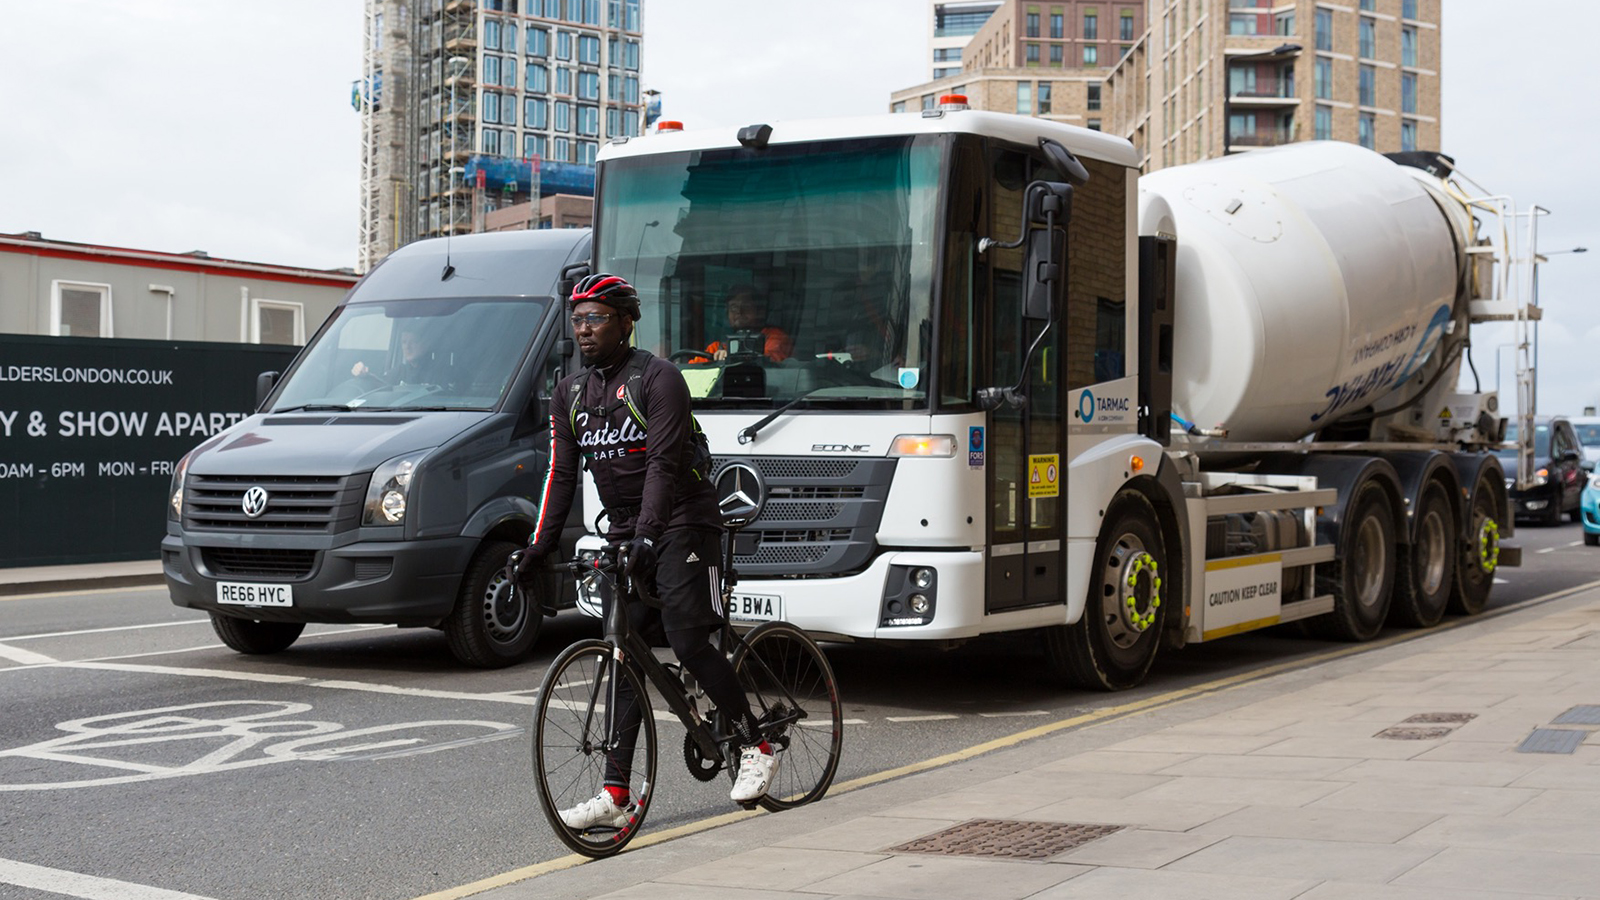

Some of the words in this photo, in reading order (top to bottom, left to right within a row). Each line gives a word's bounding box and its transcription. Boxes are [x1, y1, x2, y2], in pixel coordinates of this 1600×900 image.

[0, 366, 173, 384] LDERSLONDON.CO.UK
[1311, 353, 1406, 422] TARMAC
[1097, 398, 1129, 411] TARMAC
[0, 411, 18, 436] Y
[27, 411, 47, 437] &
[59, 411, 148, 437] SHOW
[594, 448, 625, 460] CAFE
[811, 444, 870, 452] ECONIC
[970, 451, 984, 460] FORS
[51, 463, 85, 477] 6PM
[99, 462, 135, 476] MON
[151, 461, 174, 475] FRI
[222, 585, 255, 602] RE66
[258, 587, 286, 603] HYC
[1209, 589, 1240, 607] CAUTION
[1241, 585, 1257, 599] KEEP
[1258, 581, 1277, 597] CLEAR
[743, 597, 773, 616] BWA
